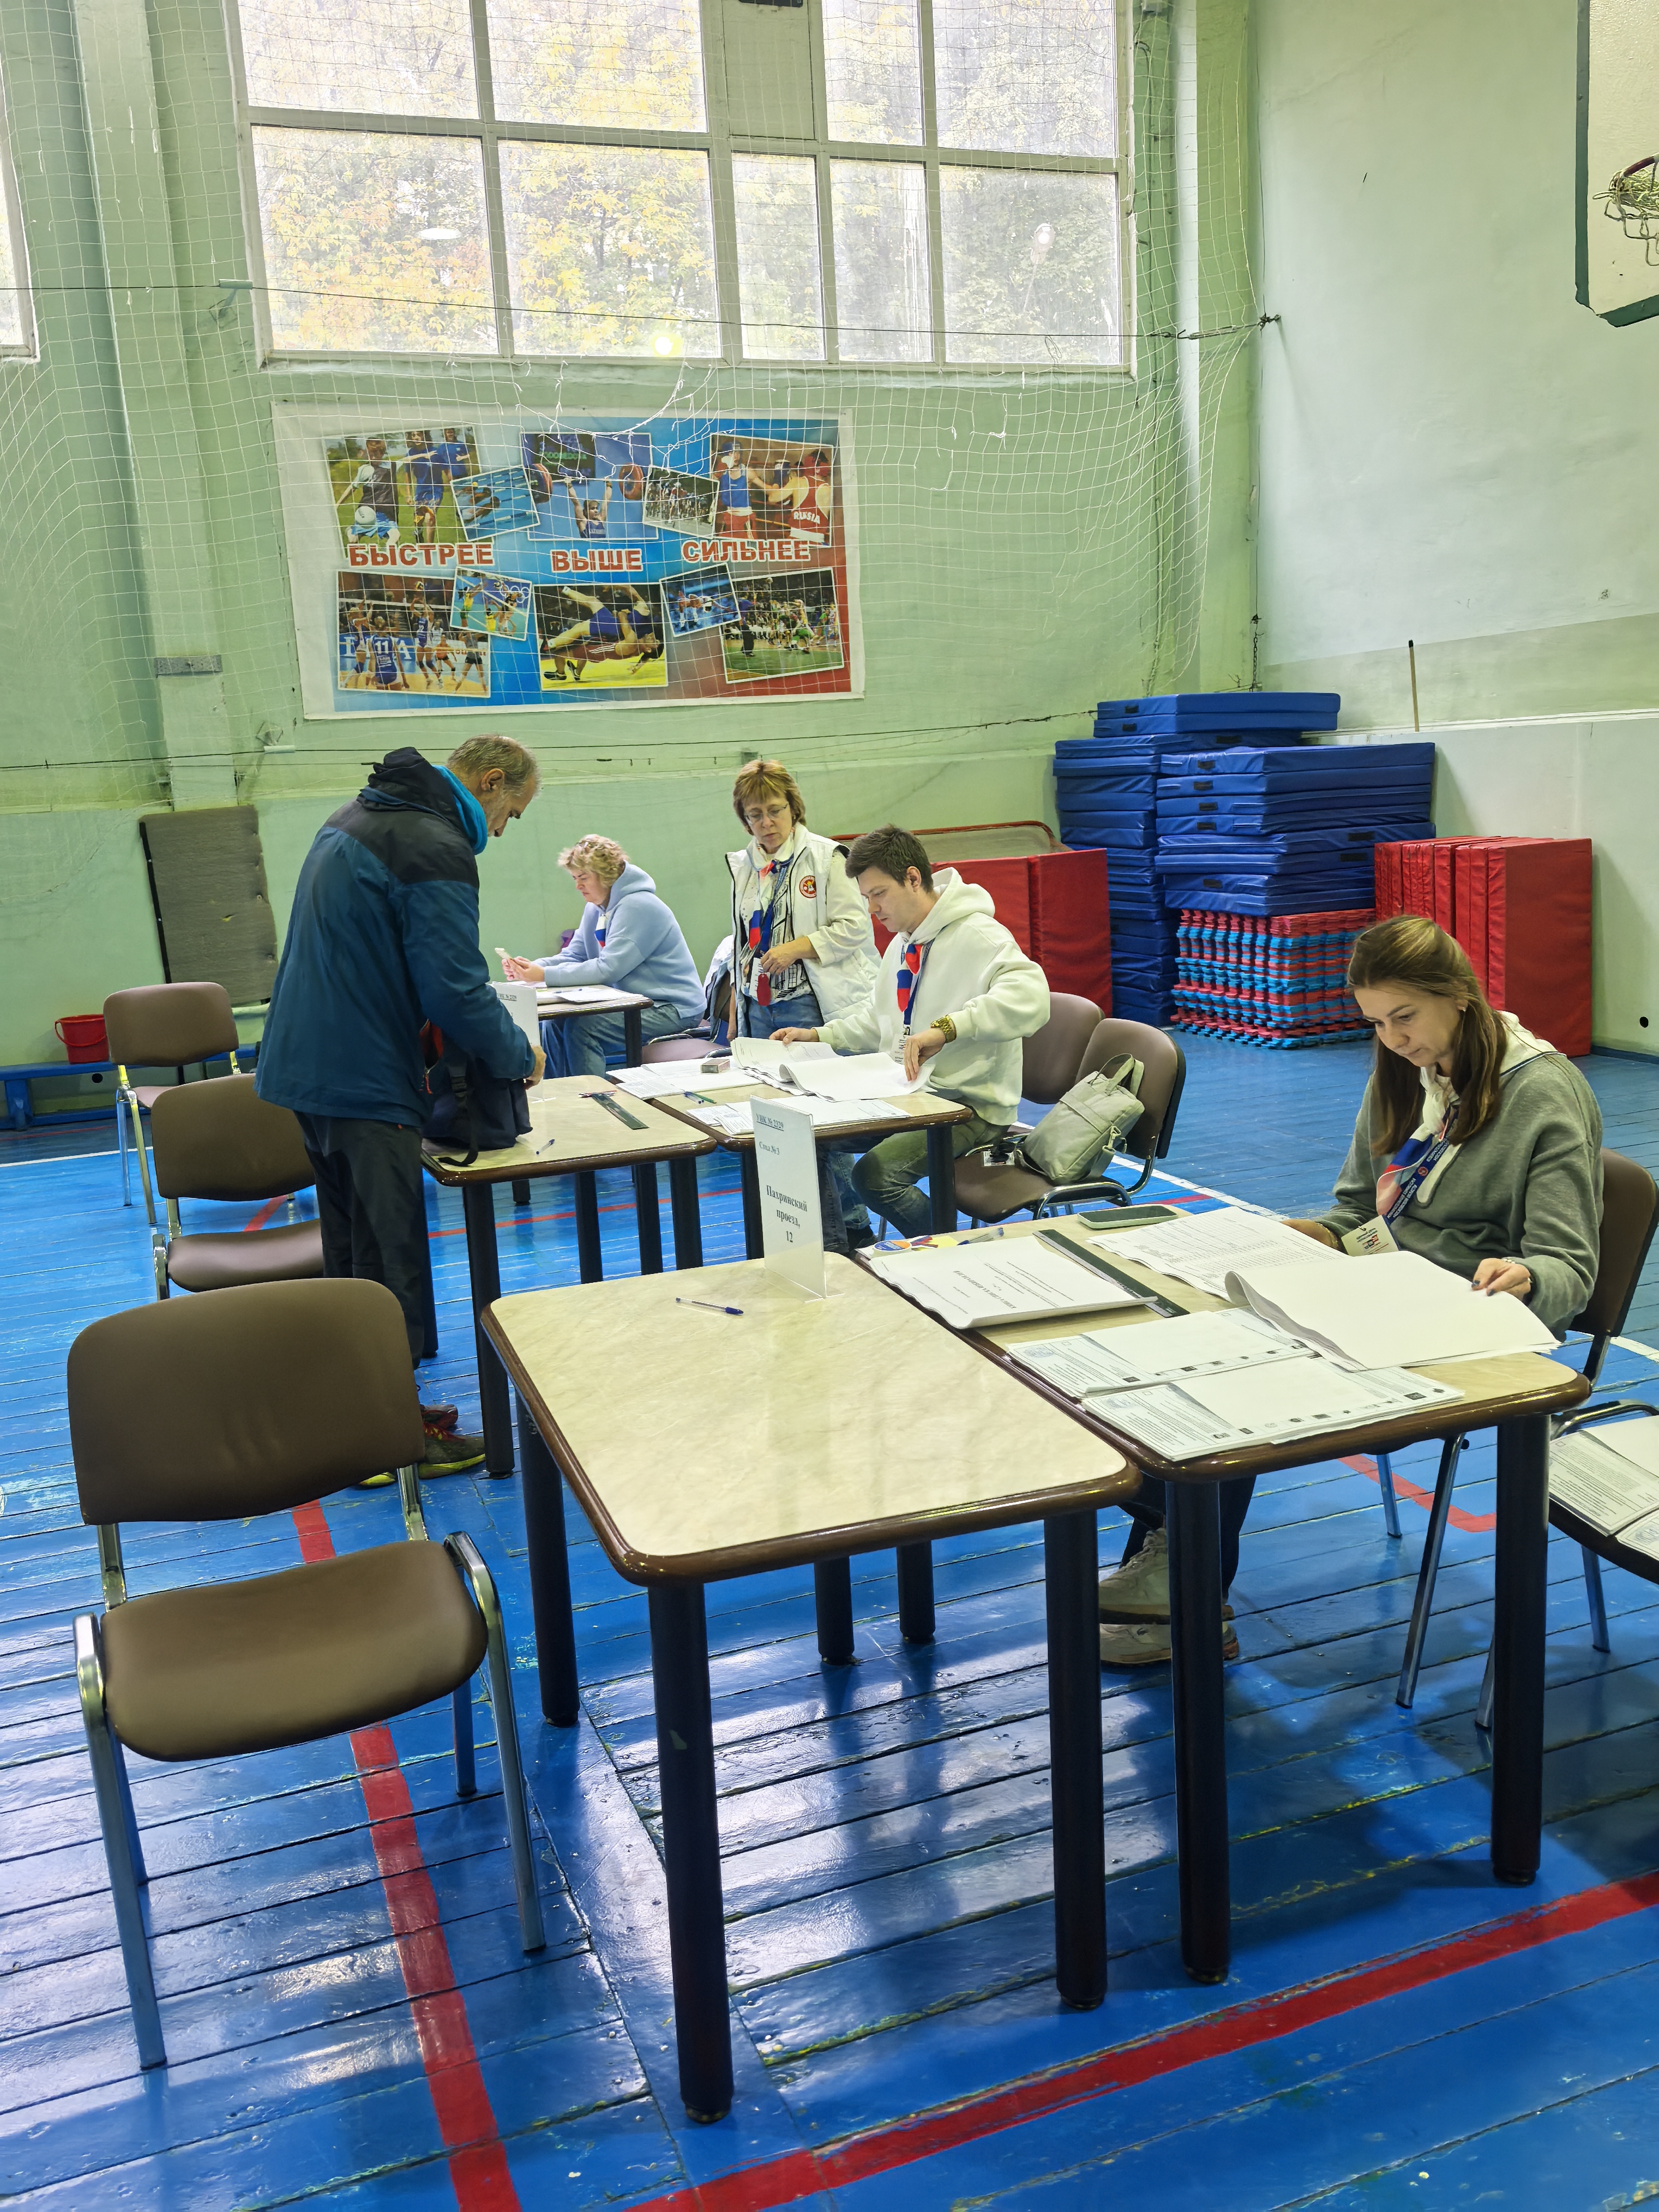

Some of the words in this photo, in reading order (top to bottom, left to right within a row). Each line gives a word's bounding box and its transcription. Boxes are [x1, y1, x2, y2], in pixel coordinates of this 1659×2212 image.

[793, 511, 820, 524] RUSSIA
[348, 543, 494, 567] БЫСТРЕЕ
[551, 549, 643, 571] ВЫШЕ
[682, 540, 810, 562] СИЛЬНЕЕ
[375, 640, 389, 655] 11
[766, 1184, 807, 1212] Пахринский
[776, 1209, 801, 1229] проезд,
[786, 1231, 793, 1243] 12
